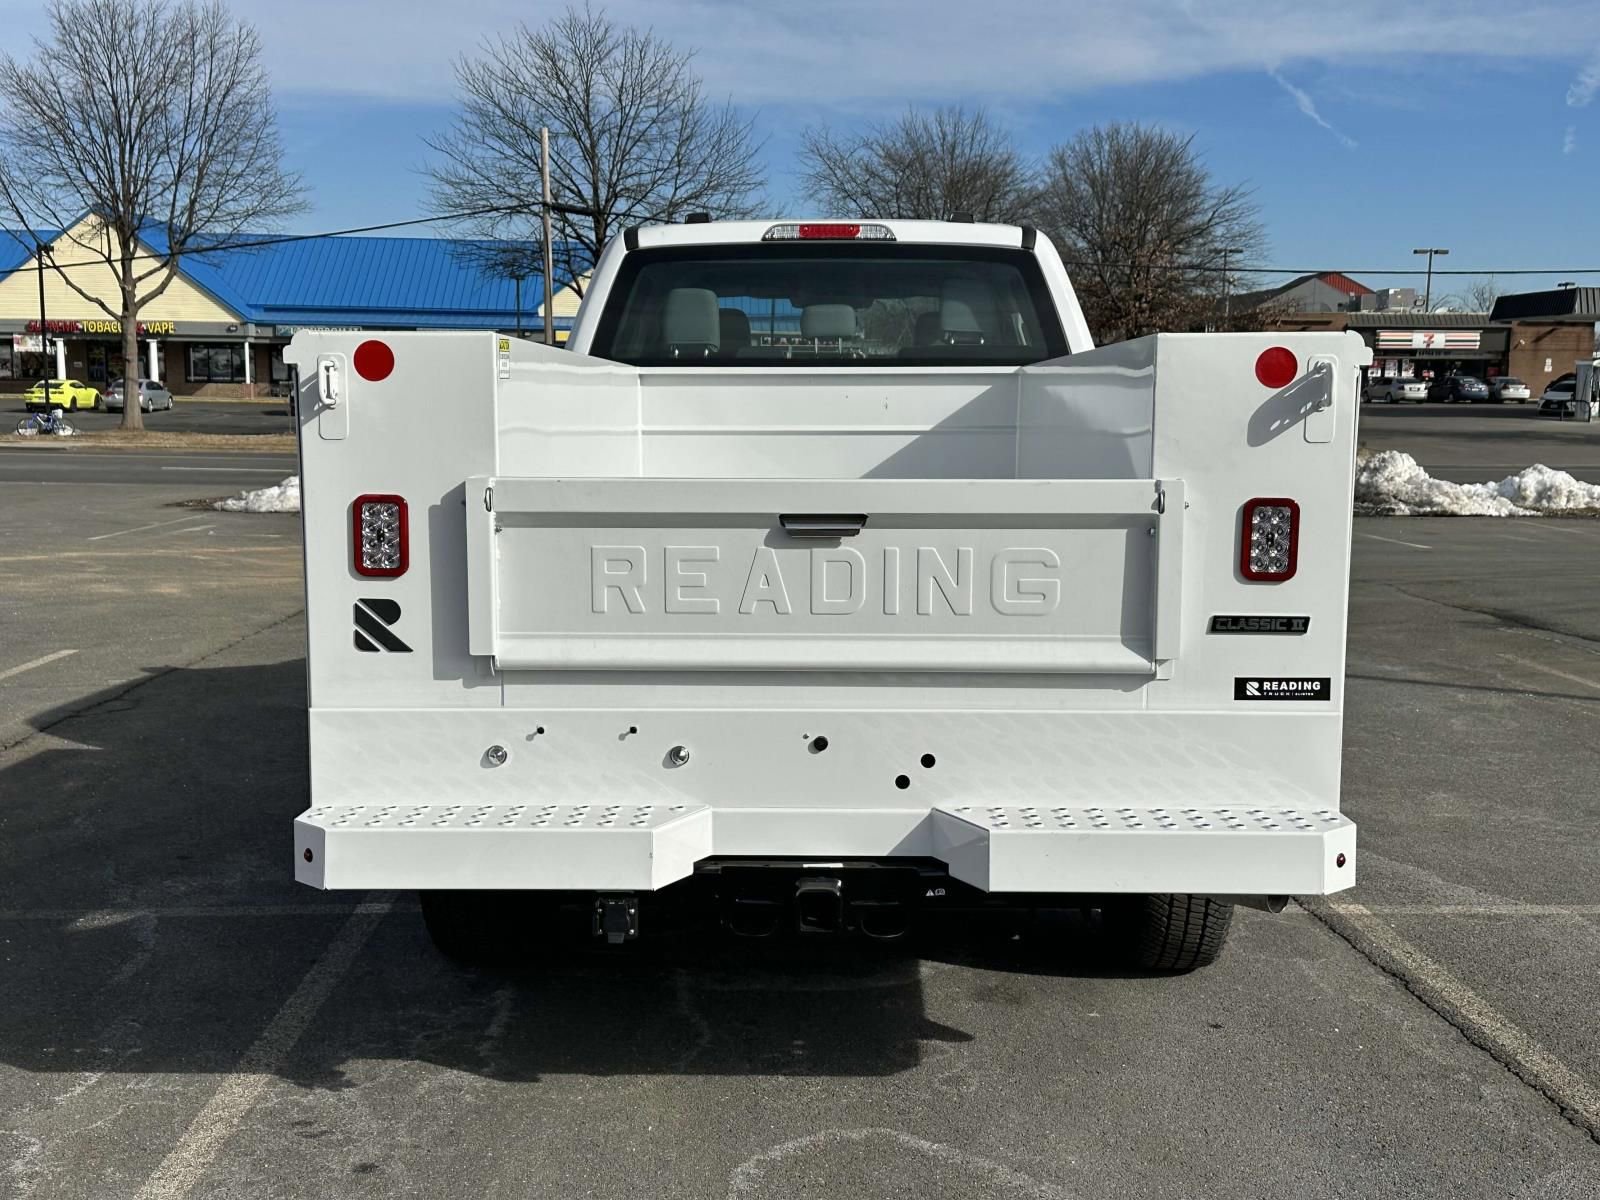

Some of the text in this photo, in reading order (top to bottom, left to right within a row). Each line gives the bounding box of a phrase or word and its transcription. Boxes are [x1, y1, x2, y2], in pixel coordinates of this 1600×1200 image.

[28, 320, 82, 334] SUREME
[147, 321, 175, 335] VAPE
[590, 545, 1061, 616] READING
[1215, 618, 1305, 630] CLASSIC II
[1263, 681, 1321, 691] READING
